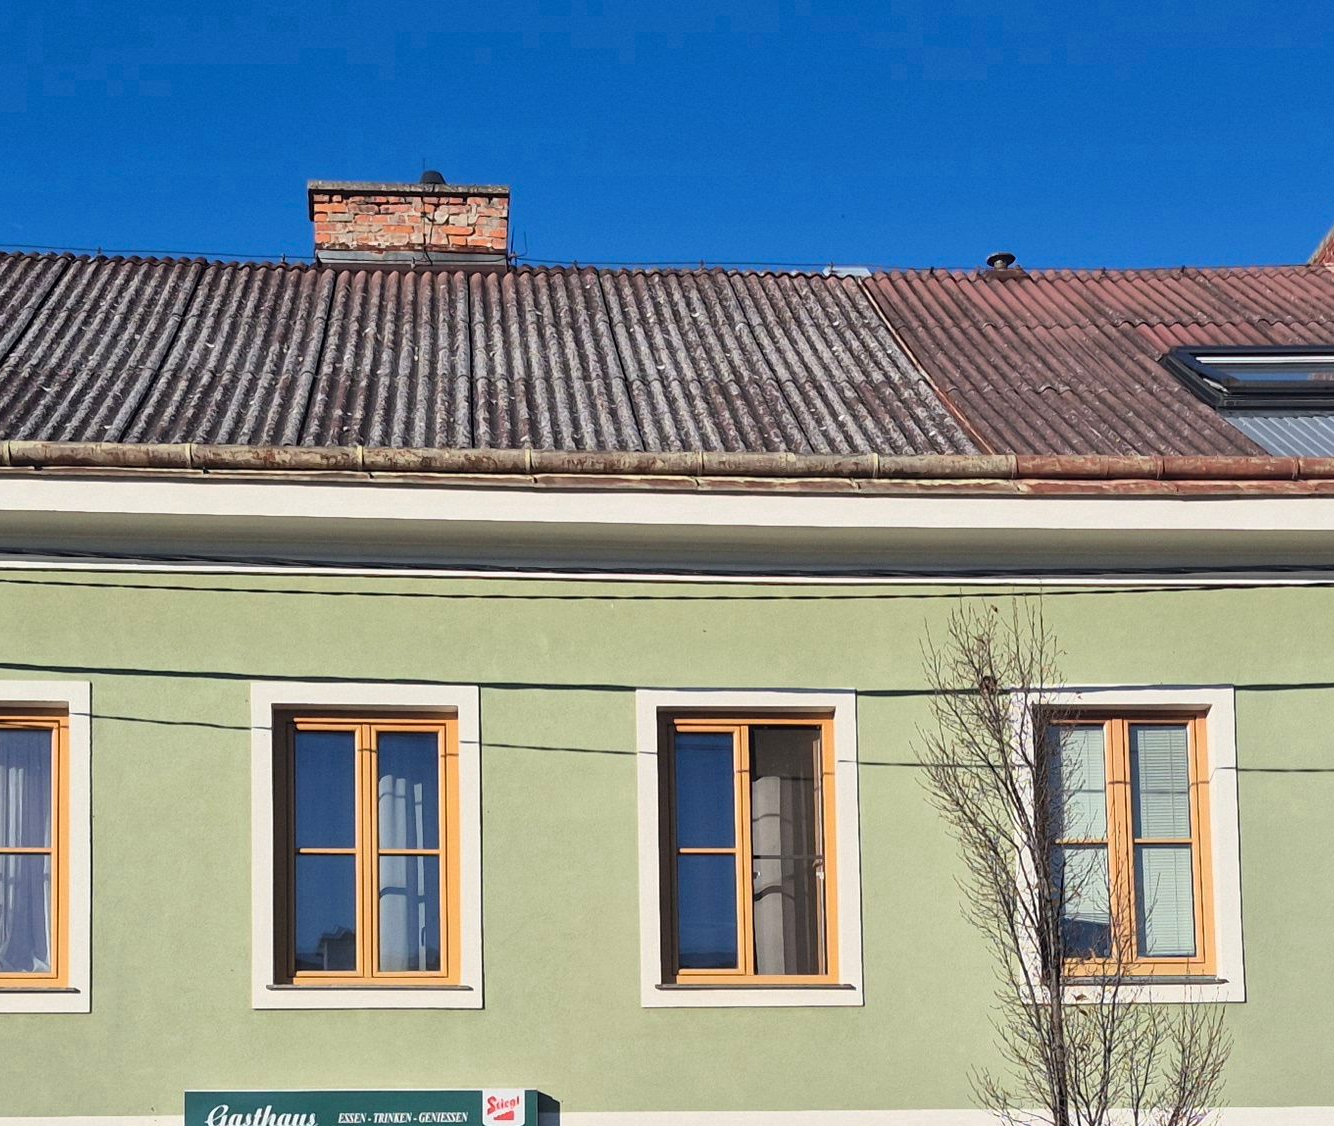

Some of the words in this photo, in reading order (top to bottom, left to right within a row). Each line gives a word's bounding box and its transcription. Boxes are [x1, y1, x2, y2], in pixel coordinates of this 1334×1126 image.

[487, 1095, 520, 1115] Stiegl
[337, 1112, 366, 1124] ESSEN
[373, 1112, 412, 1124] TRINKEN
[418, 1111, 468, 1123] GENIESSEN
